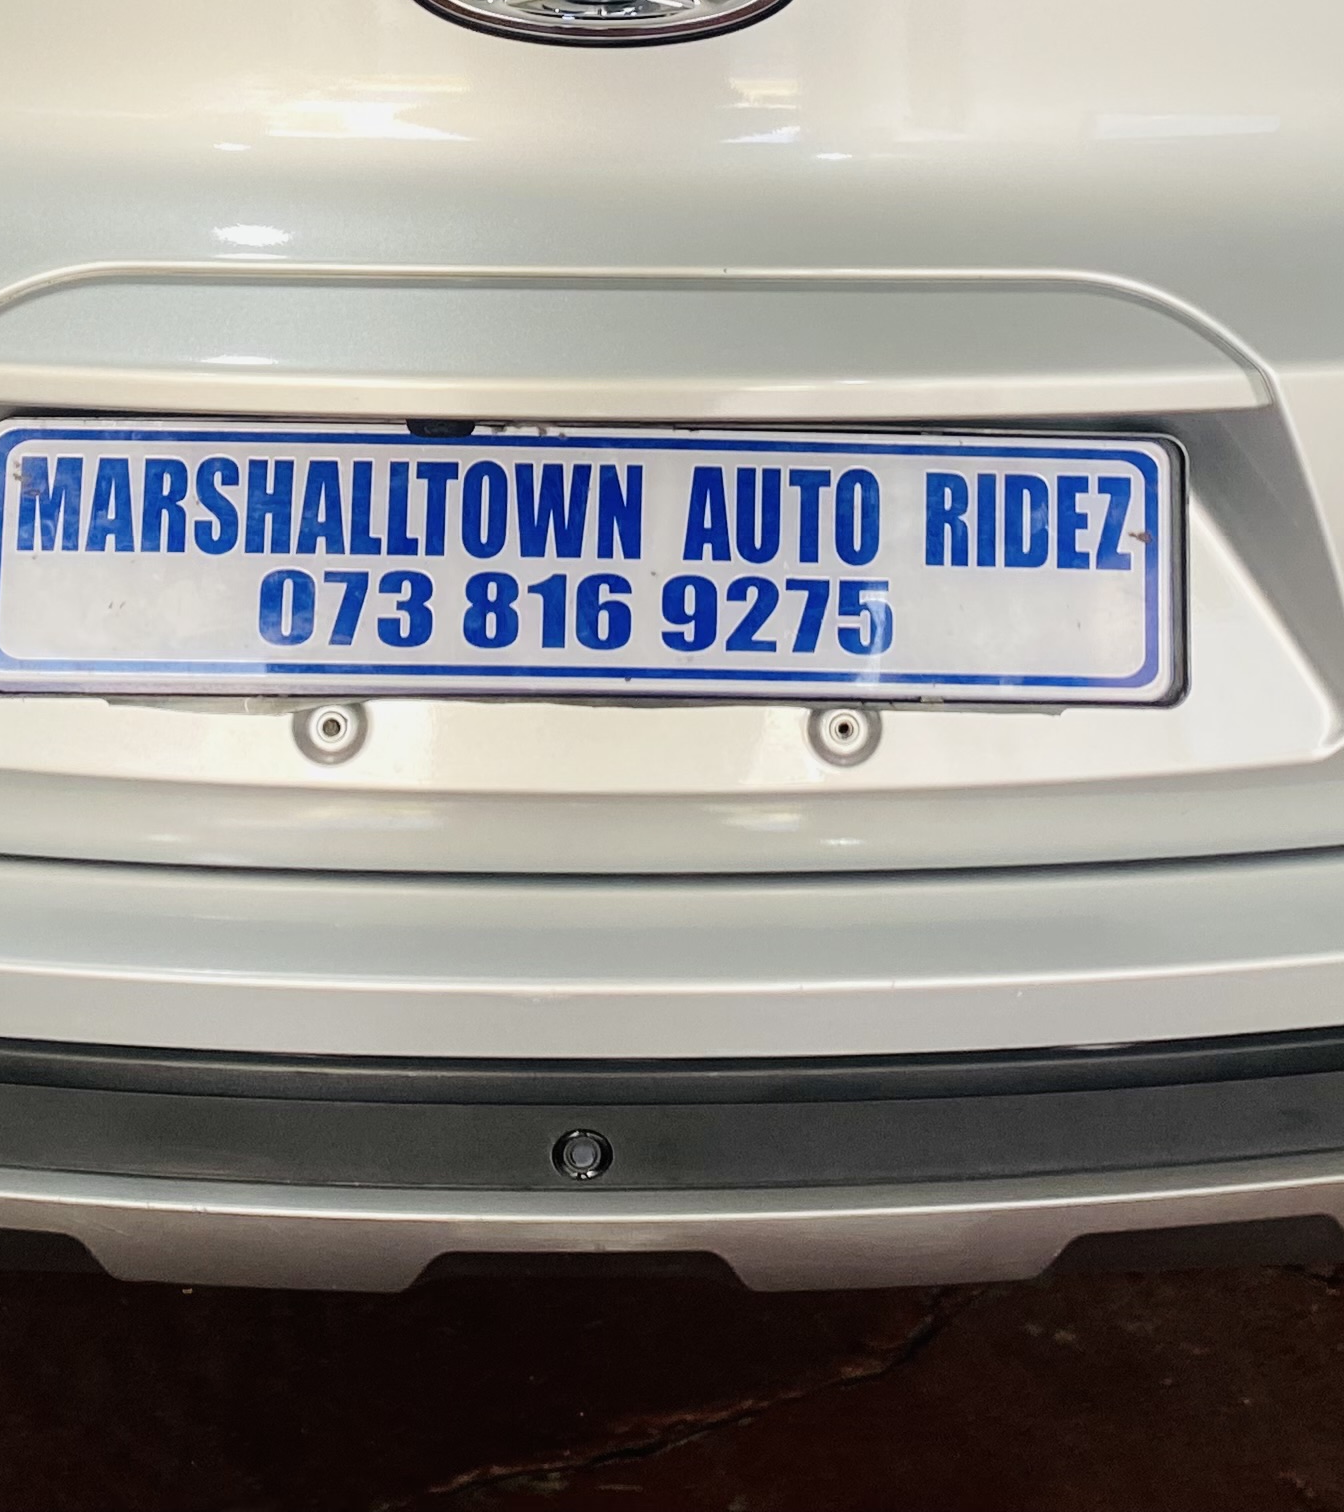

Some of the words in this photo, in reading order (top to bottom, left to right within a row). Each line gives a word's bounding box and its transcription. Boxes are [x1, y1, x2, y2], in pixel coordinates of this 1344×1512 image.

[16, 455, 643, 560] MARSHALLTOWN
[682, 466, 880, 566] AUTO
[924, 472, 1132, 570] RIDEZ
[258, 568, 434, 648] 073
[462, 570, 632, 650] 816
[661, 574, 894, 656] 9275
